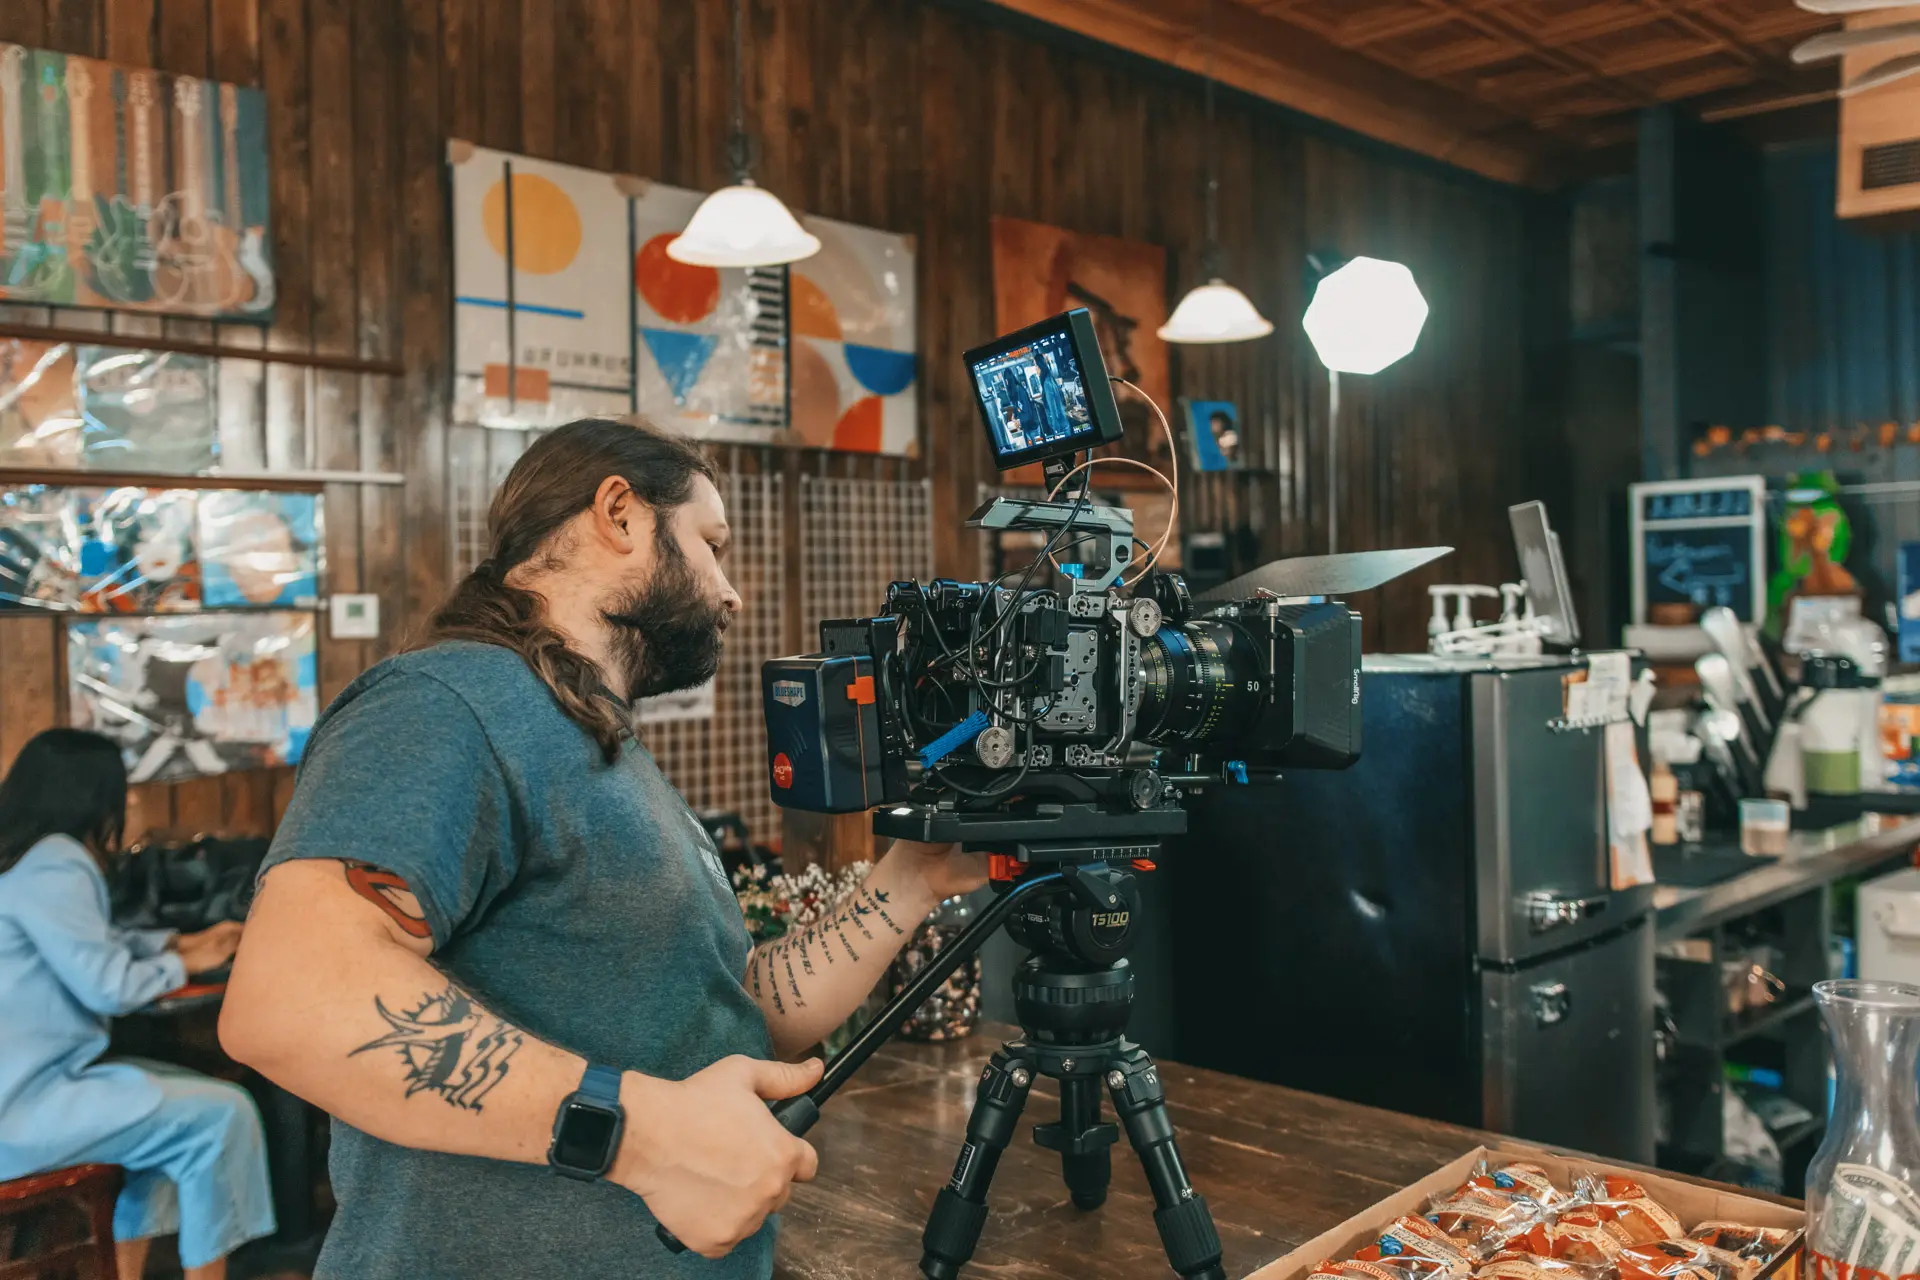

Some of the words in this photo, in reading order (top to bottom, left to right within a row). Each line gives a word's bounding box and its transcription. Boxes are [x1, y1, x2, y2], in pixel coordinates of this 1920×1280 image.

[775, 686, 804, 698] BLUESHAPE
[1247, 681, 1260, 692] 50
[1351, 668, 1361, 705] SmallRig
[1092, 911, 1130, 927] TS100
